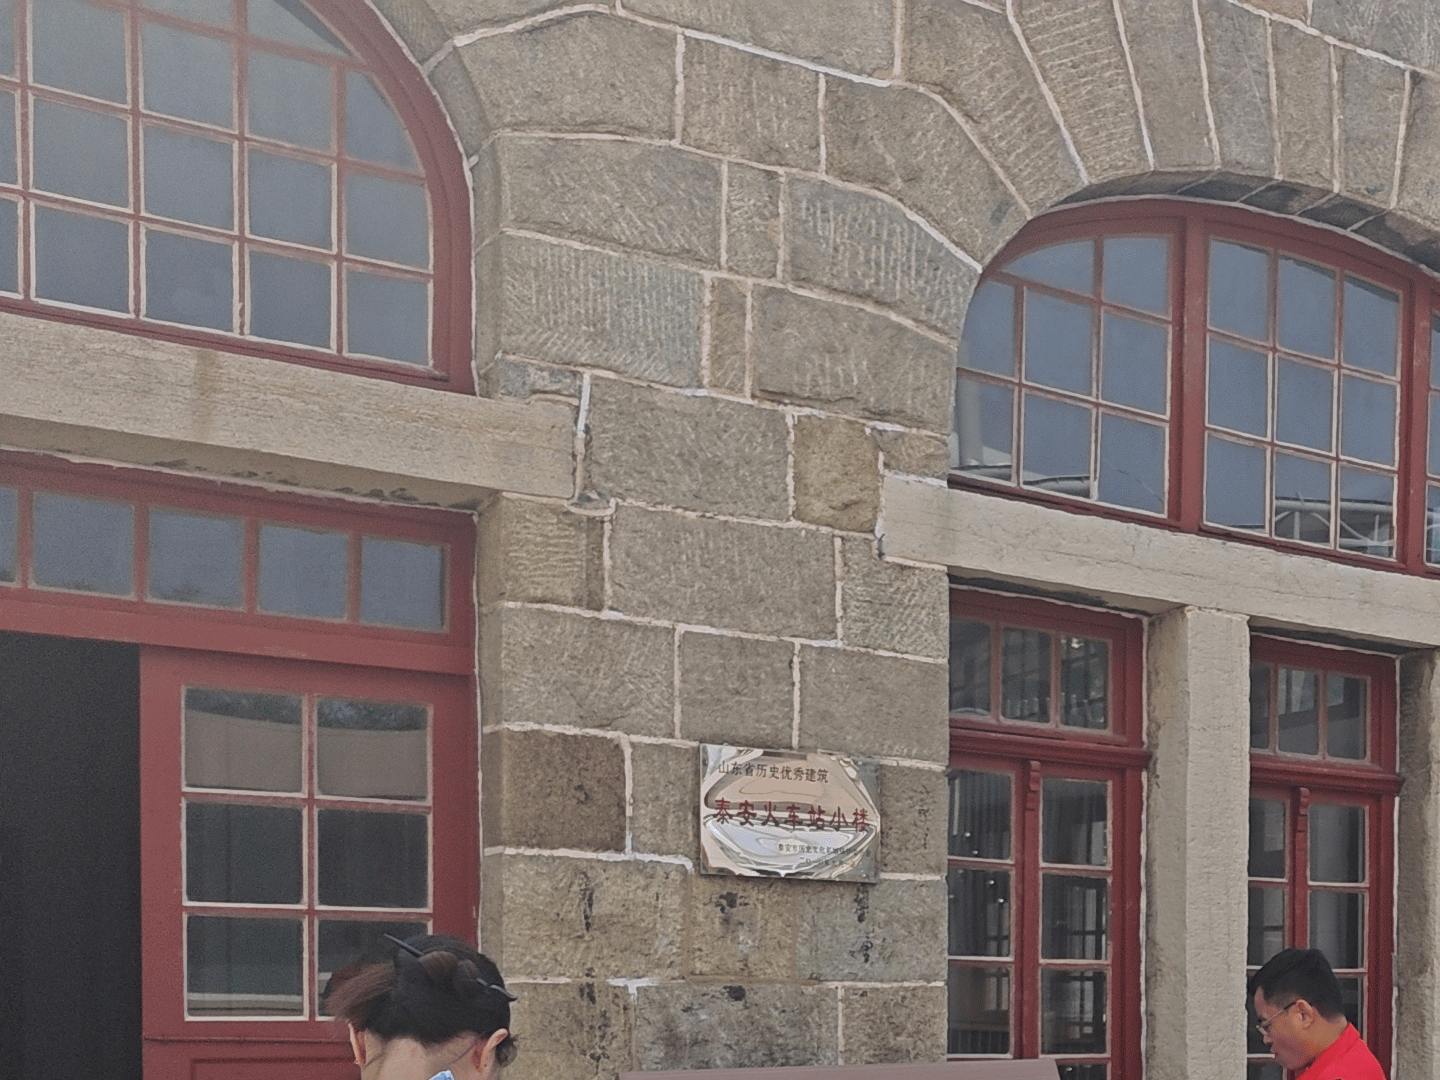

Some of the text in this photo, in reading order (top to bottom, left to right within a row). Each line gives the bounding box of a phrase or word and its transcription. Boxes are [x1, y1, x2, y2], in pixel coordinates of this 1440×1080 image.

[718, 761, 829, 784] 山东省历史优秀建筑
[712, 797, 872, 833] 泰安火车站小楼
